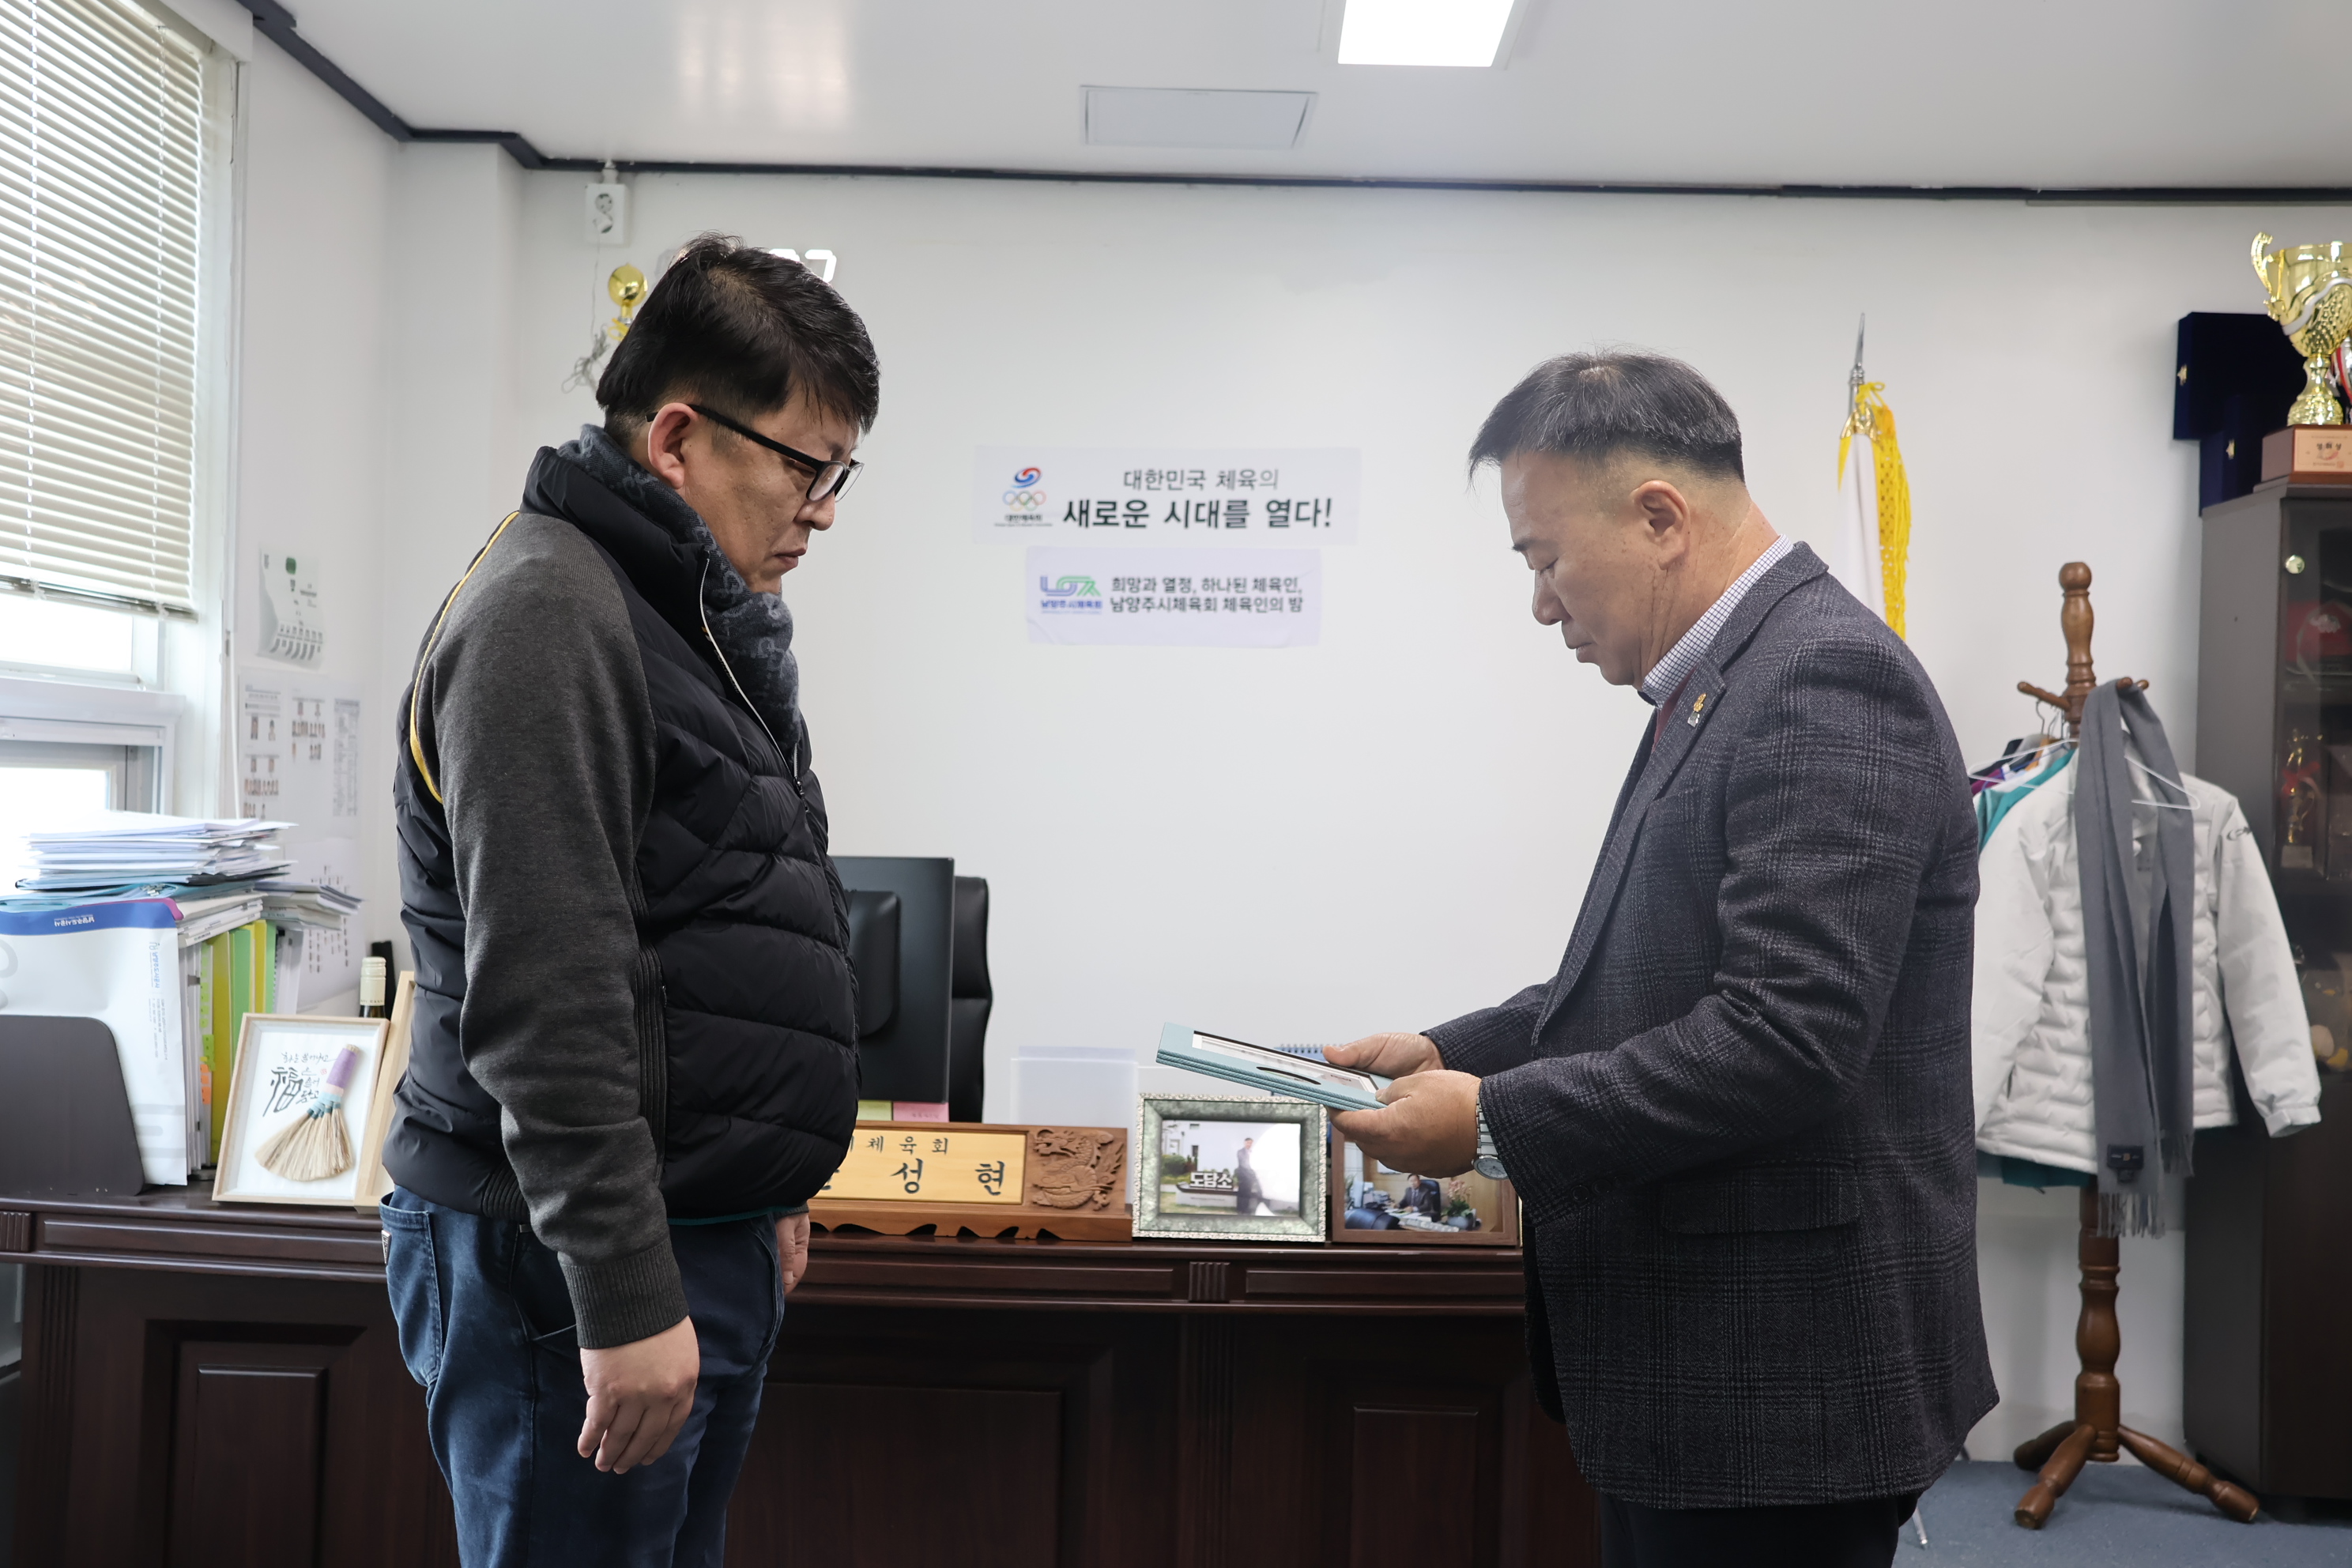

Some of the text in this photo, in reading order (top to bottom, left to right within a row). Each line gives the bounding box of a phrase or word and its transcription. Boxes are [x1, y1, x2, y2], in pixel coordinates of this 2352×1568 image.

[1123, 469, 1279, 491] 대한민국 체육의
[1062, 498, 1332, 529] 새로운 시대를 열다!
[1111, 577, 1302, 594] 희망과 열정, 하나된 체육인,
[1110, 597, 1304, 613] 남양주시체육회 체육인의 밤
[850, 1136, 949, 1155] 체육회
[1189, 1171, 1233, 1189] 도담소
